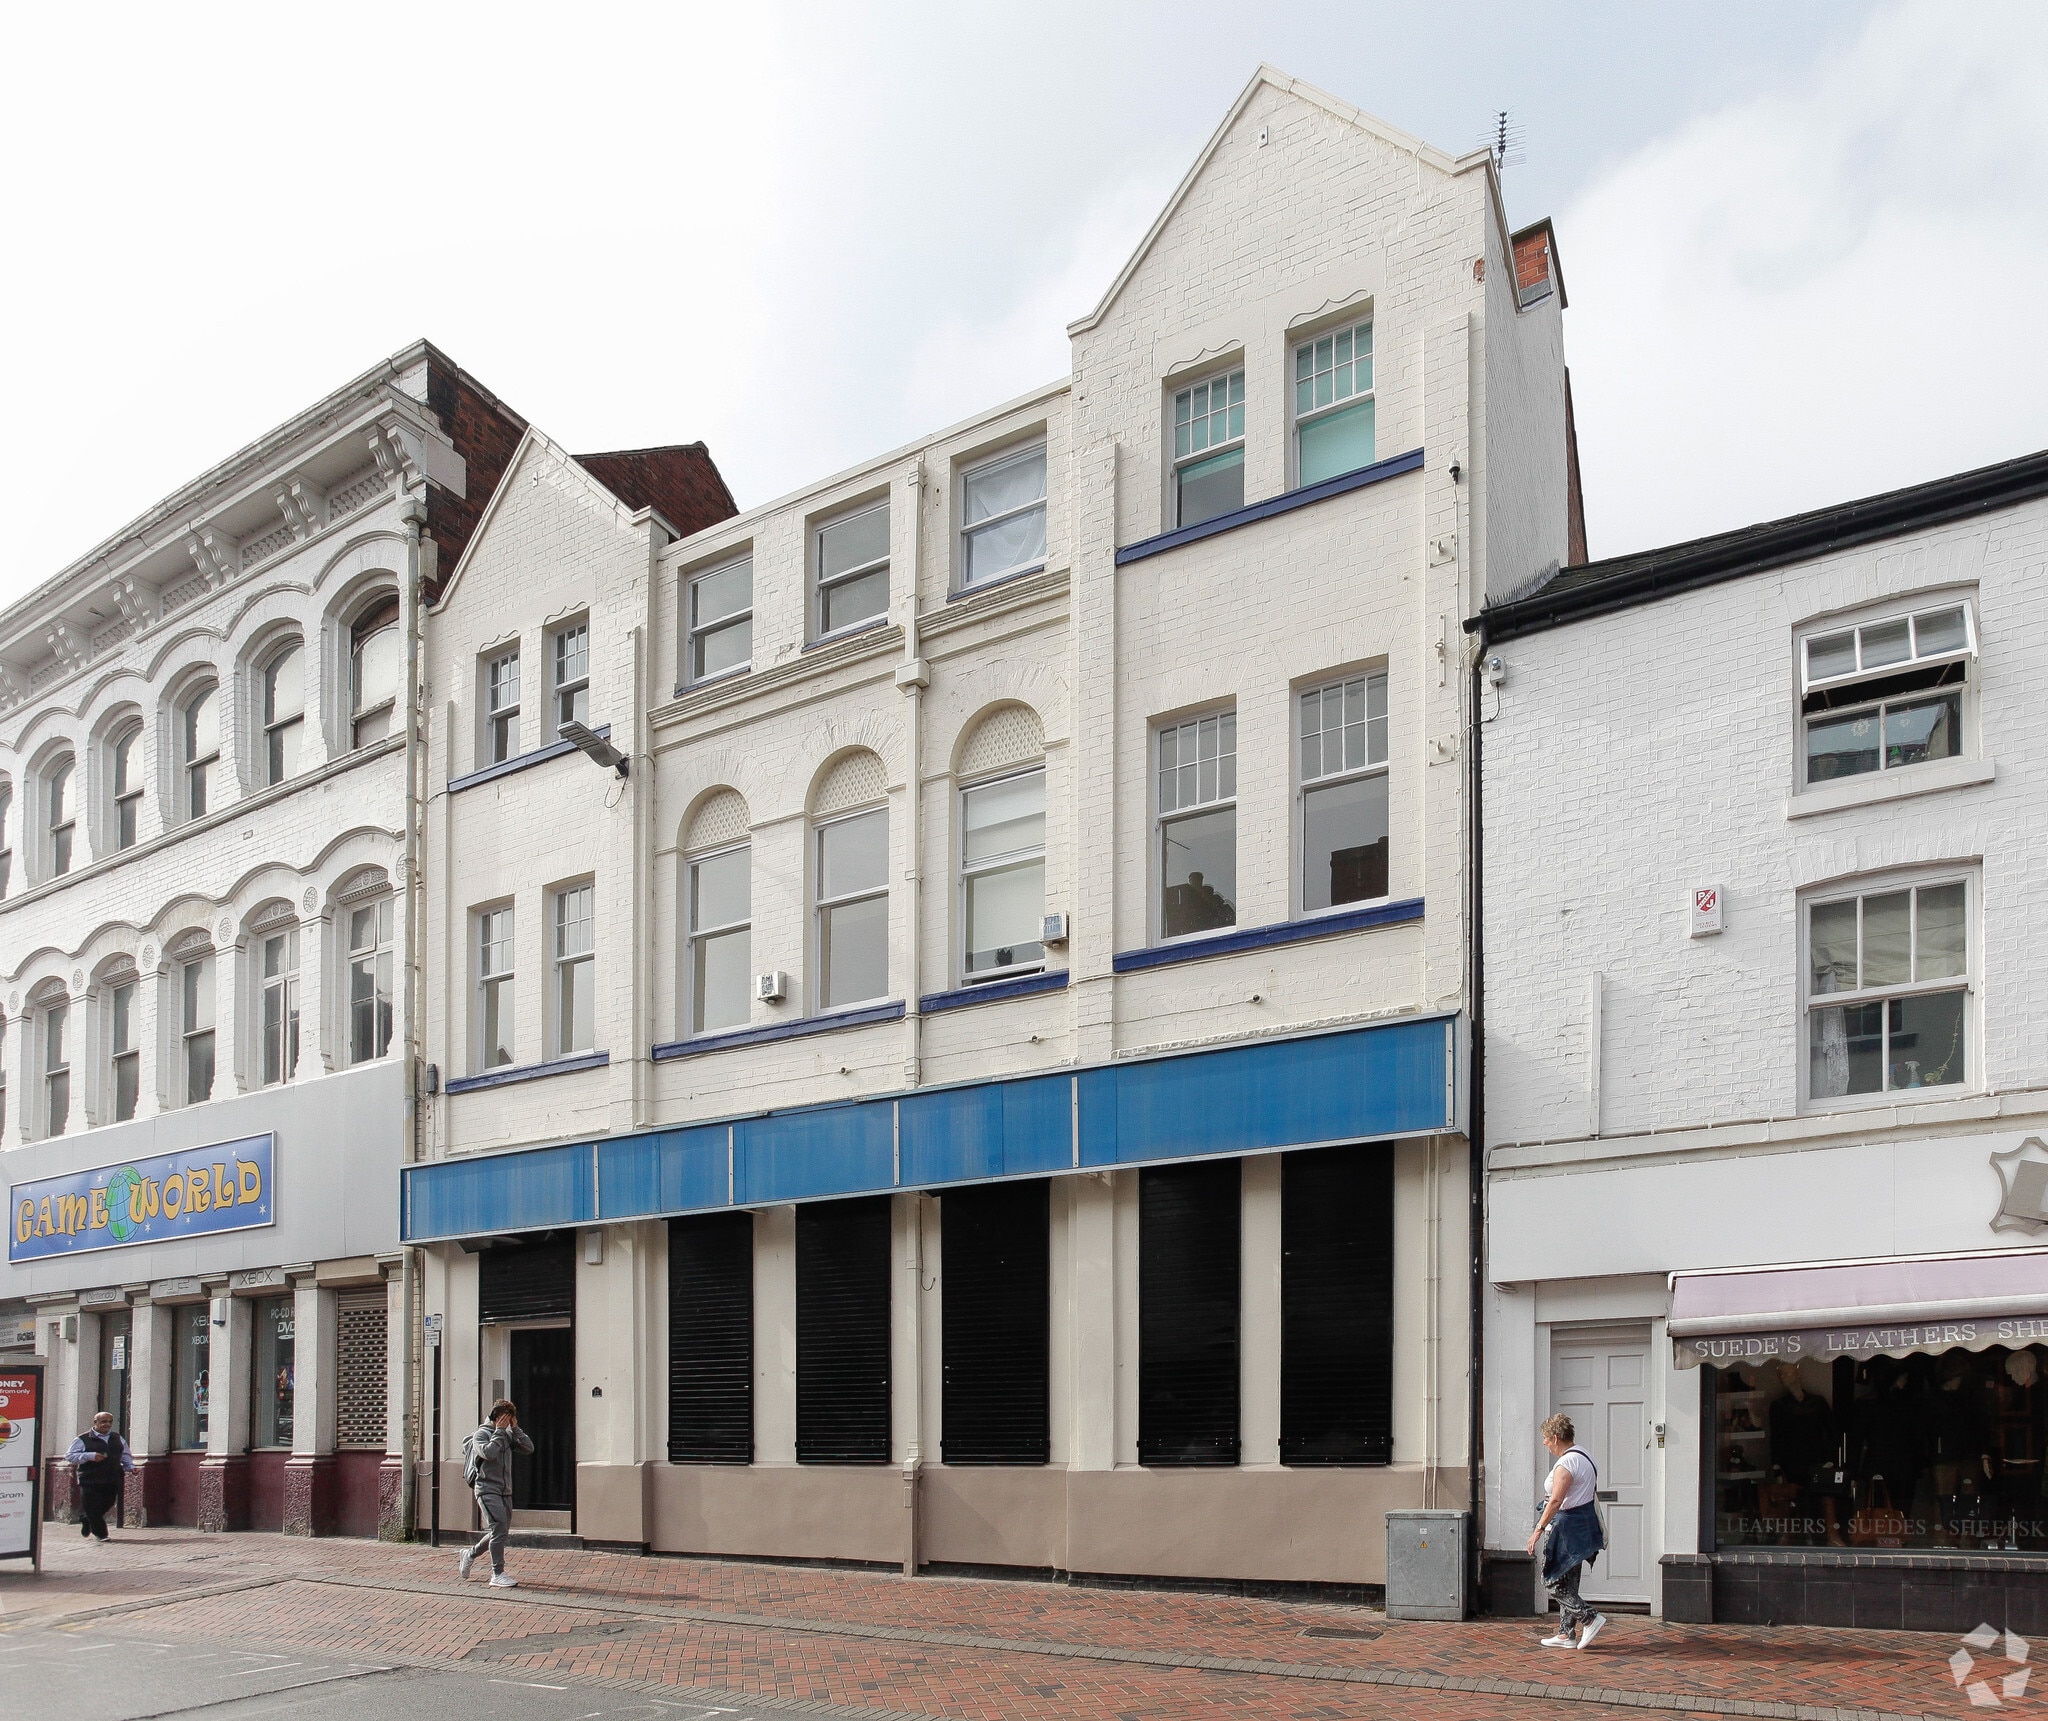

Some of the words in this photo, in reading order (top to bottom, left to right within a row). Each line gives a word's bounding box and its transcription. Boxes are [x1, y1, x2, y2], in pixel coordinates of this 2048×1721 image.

[17, 1187, 111, 1243] GAME
[128, 1158, 262, 1224] WORLD
[240, 1270, 273, 1285] XBOX
[1695, 1335, 1801, 1358] SUEDE'S
[1826, 1323, 1978, 1352] LEATHERS
[1726, 1517, 1826, 1535] LEATHERS
[1847, 1519, 1926, 1536] SUEDES
